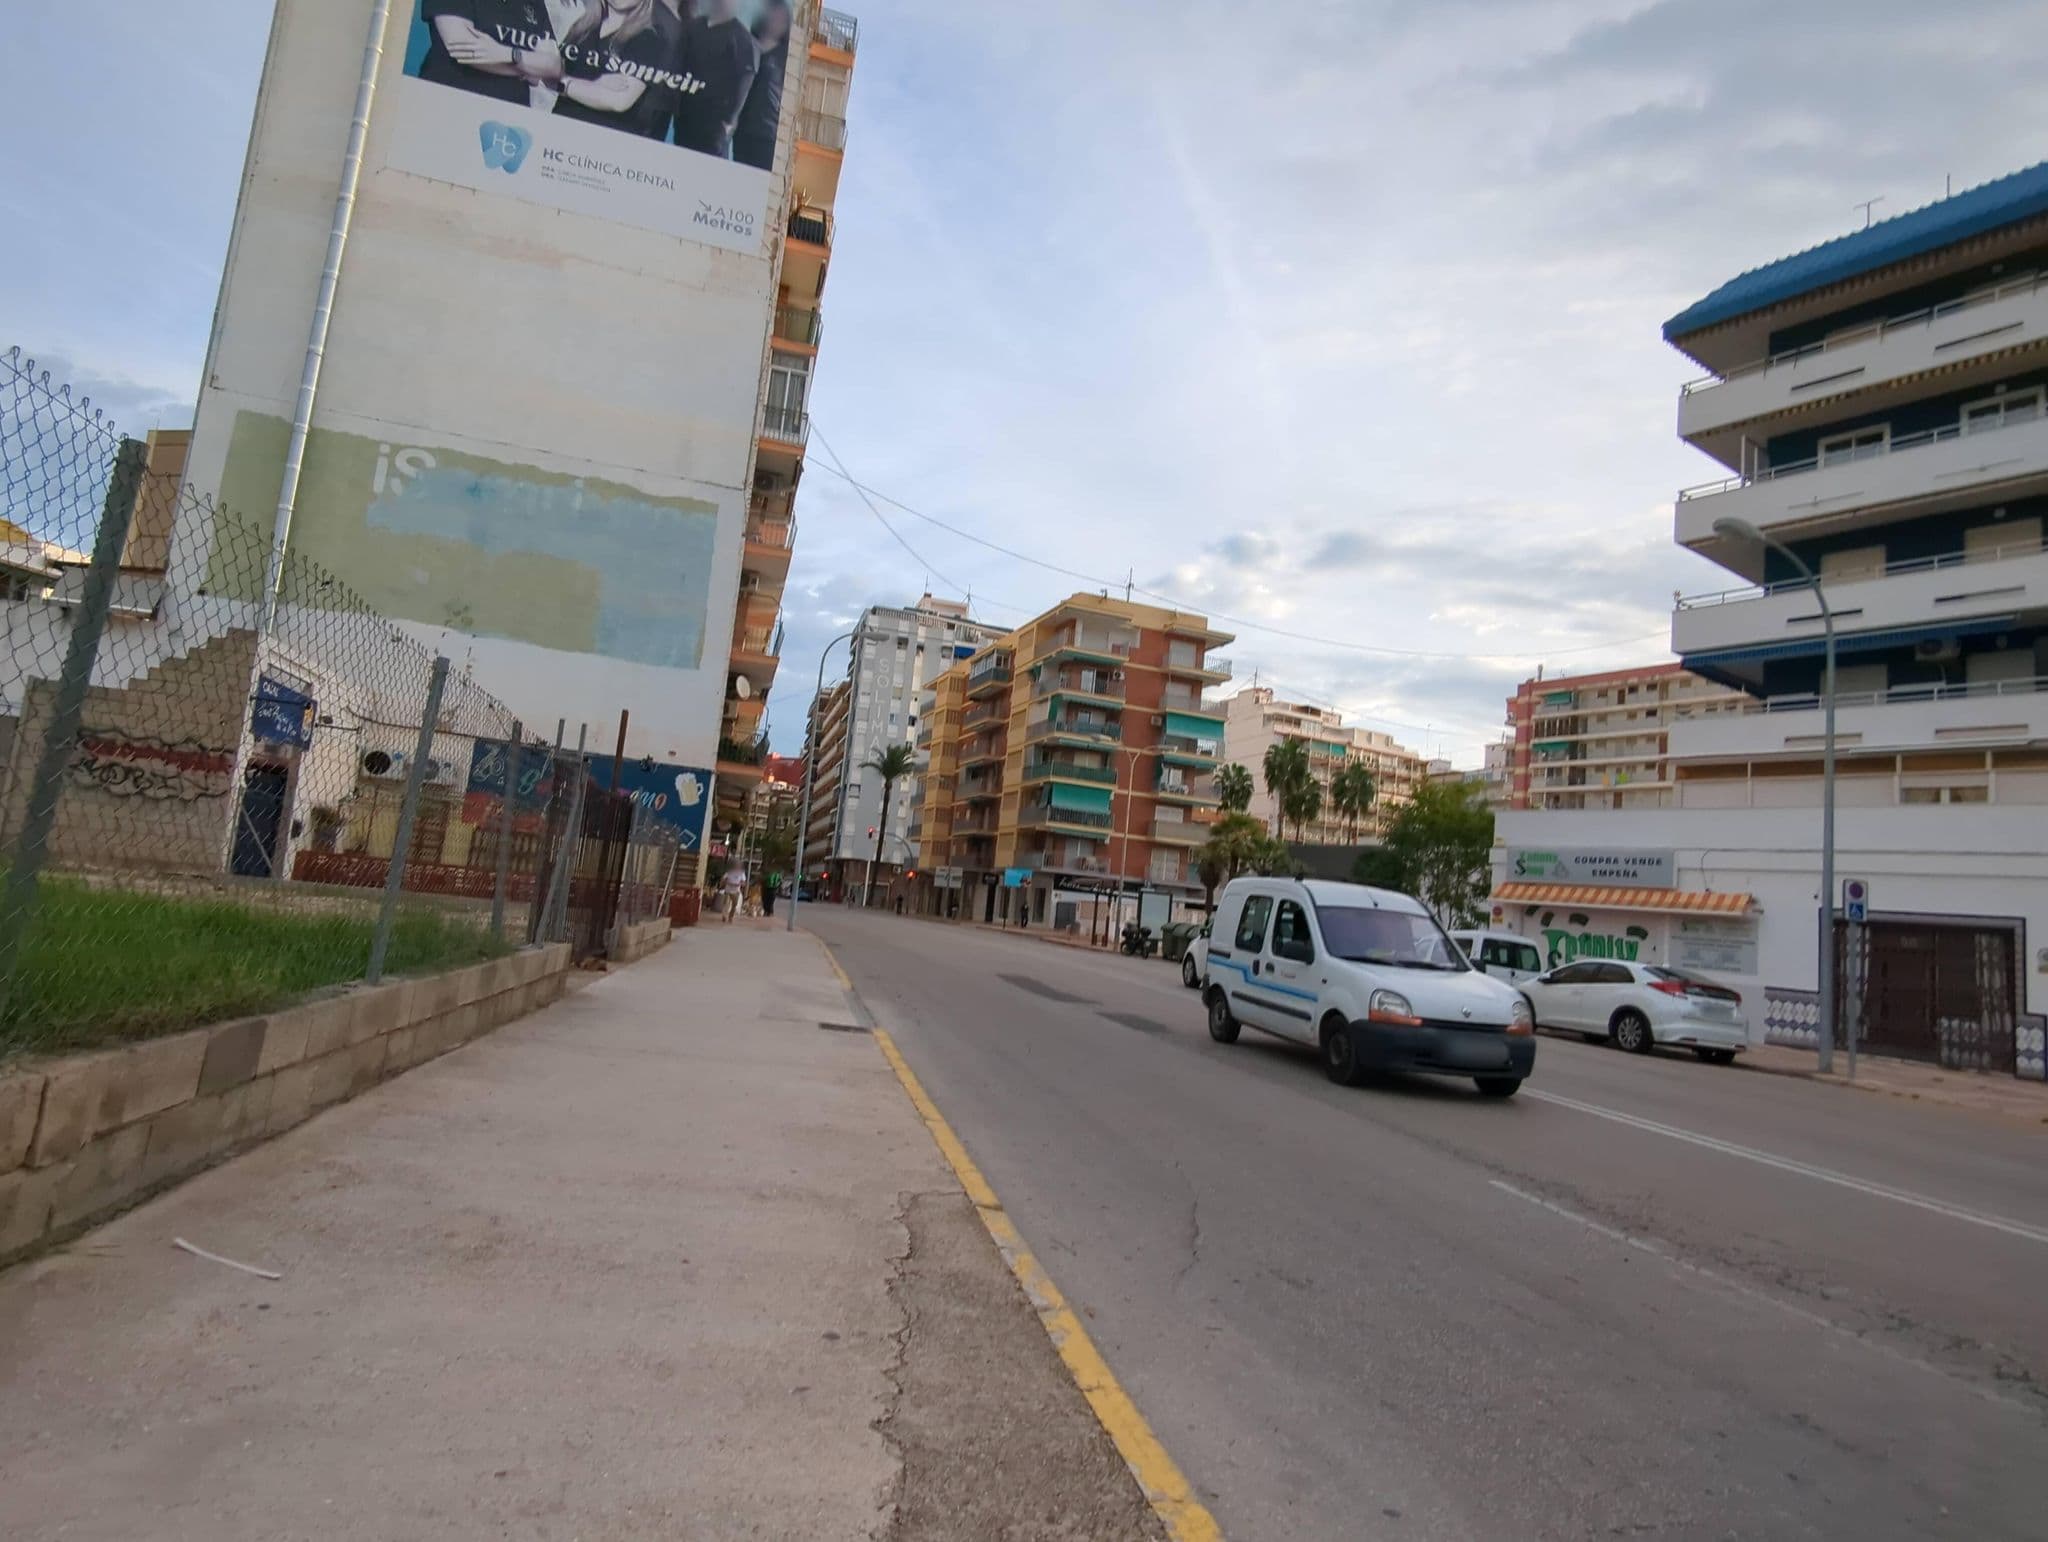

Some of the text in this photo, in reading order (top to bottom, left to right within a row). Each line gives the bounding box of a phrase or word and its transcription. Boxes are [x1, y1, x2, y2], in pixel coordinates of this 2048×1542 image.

[586, 50, 599, 68] a
[492, 132, 517, 157] HC
[543, 148, 564, 163] HC
[568, 153, 622, 177] CLÍNICA
[626, 168, 676, 191] DENTAL
[693, 211, 752, 236] Metros
[1574, 855, 1663, 867] COMPRA VENDE
